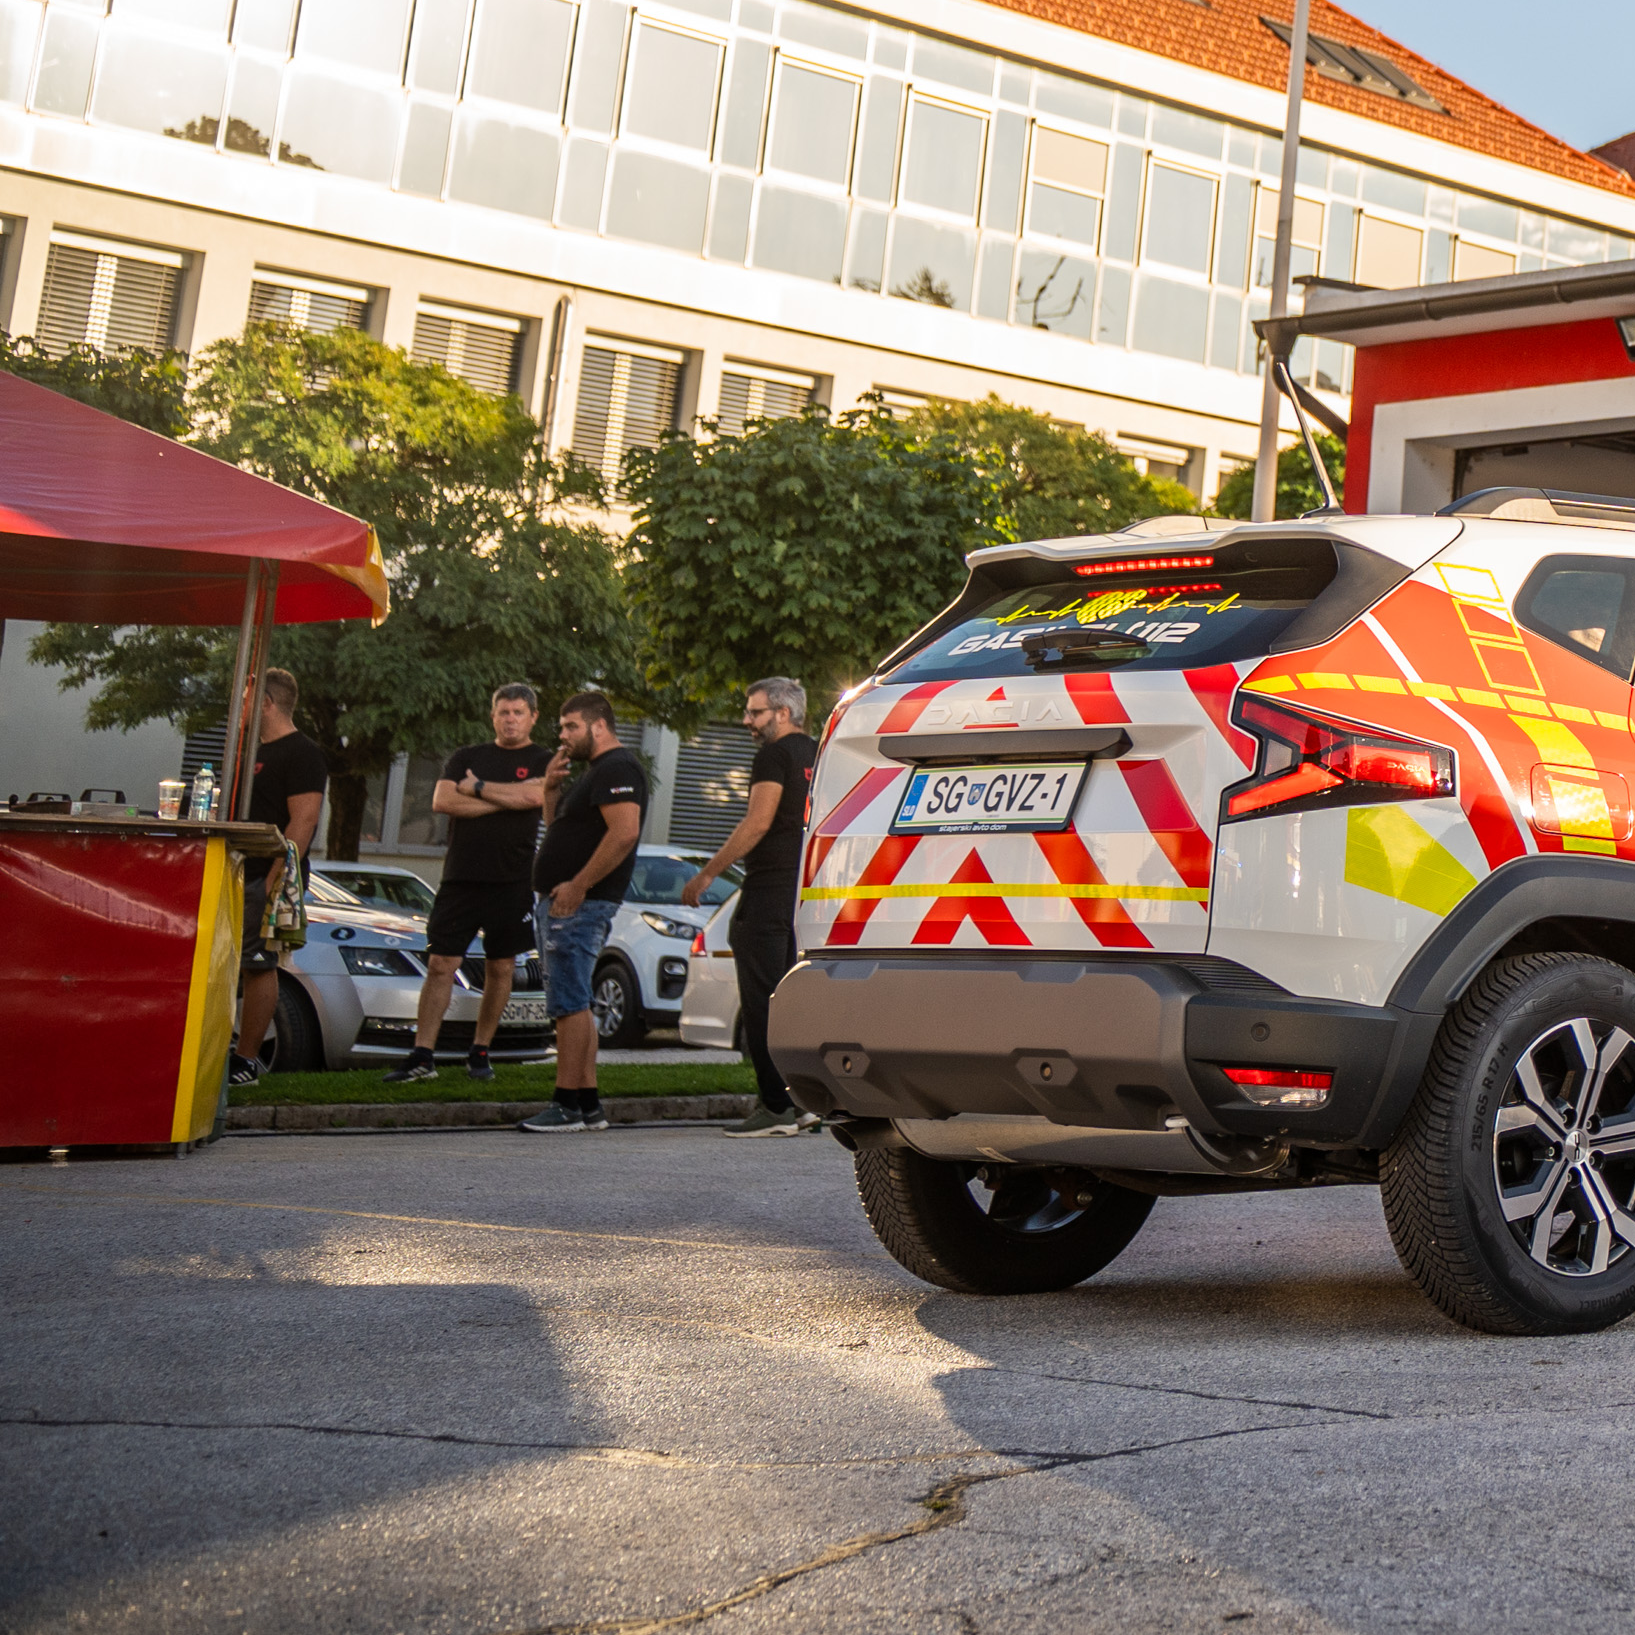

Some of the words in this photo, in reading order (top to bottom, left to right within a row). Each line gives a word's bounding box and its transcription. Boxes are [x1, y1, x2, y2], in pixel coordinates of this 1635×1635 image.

[927, 699, 1063, 726] DACIA
[926, 775, 968, 814] SG
[983, 773, 1068, 812] GVZ-1
[1471, 1094, 1490, 1152] 215/65
[1482, 1075, 1495, 1092] R
[1490, 1058, 1501, 1075] 17
[1498, 1042, 1509, 1057] H
